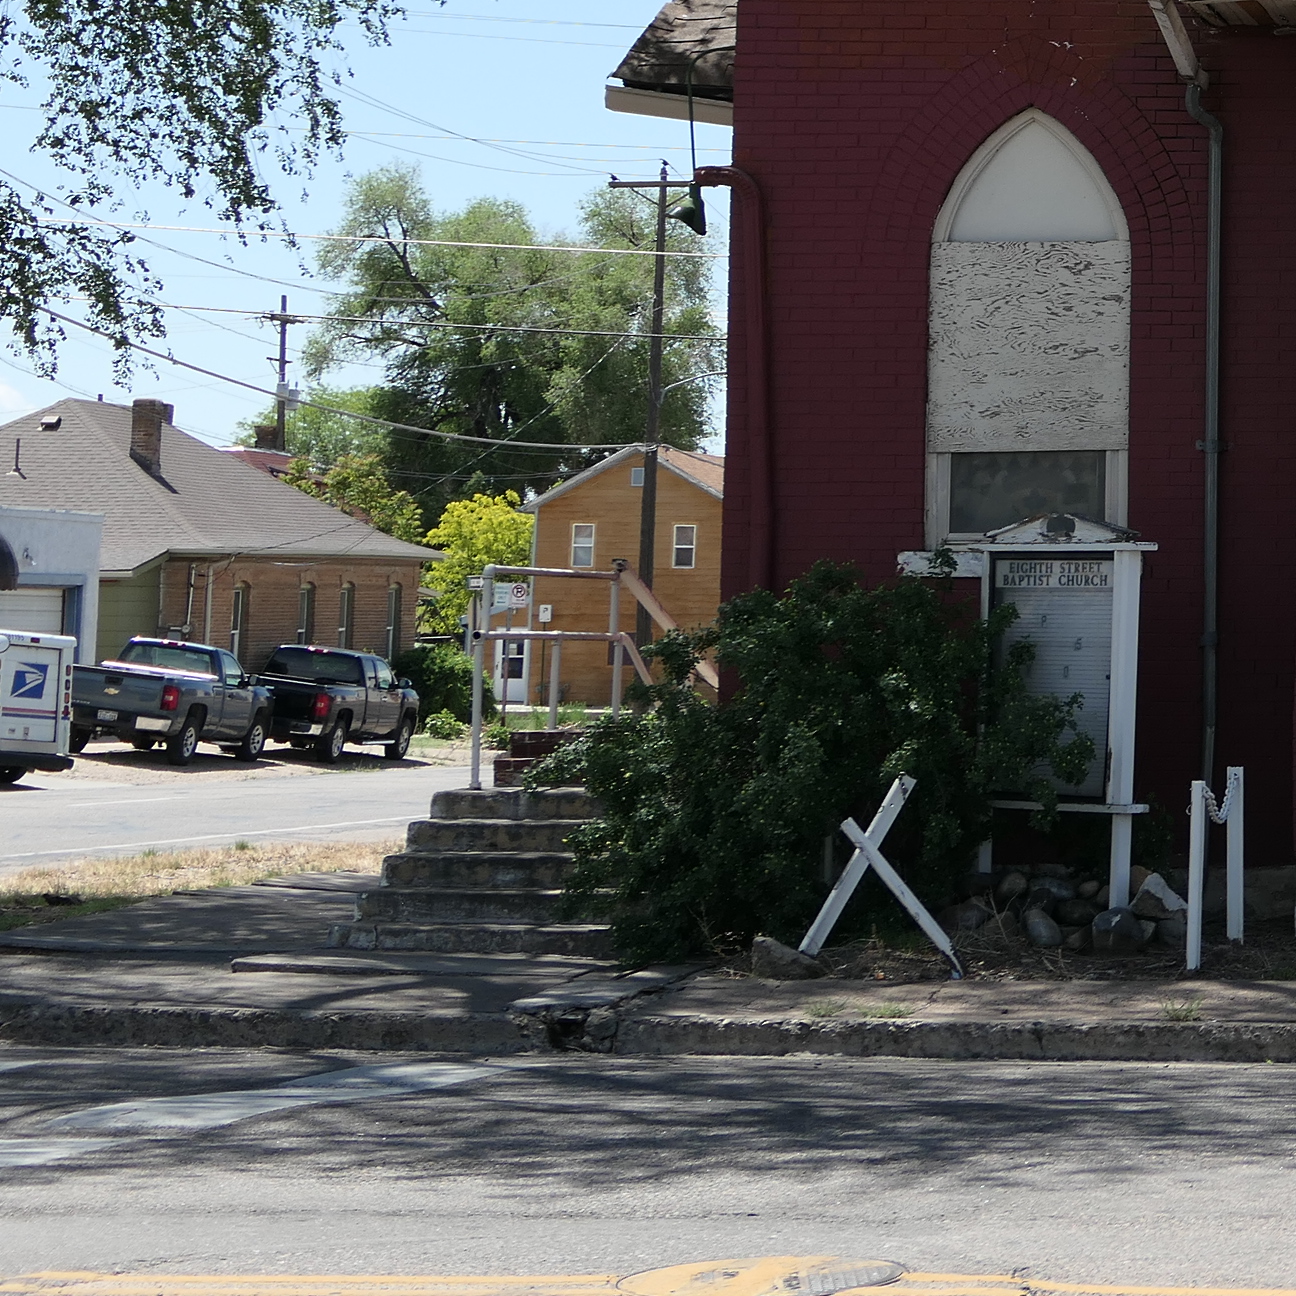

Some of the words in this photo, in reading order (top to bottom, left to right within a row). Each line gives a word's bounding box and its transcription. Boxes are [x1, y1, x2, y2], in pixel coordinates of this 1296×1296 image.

[1009, 562, 1053, 573] EIGHTH
[1059, 562, 1103, 573] STREET
[1003, 574, 1052, 586] BAPTIST
[1058, 574, 1108, 586] CHURCH
